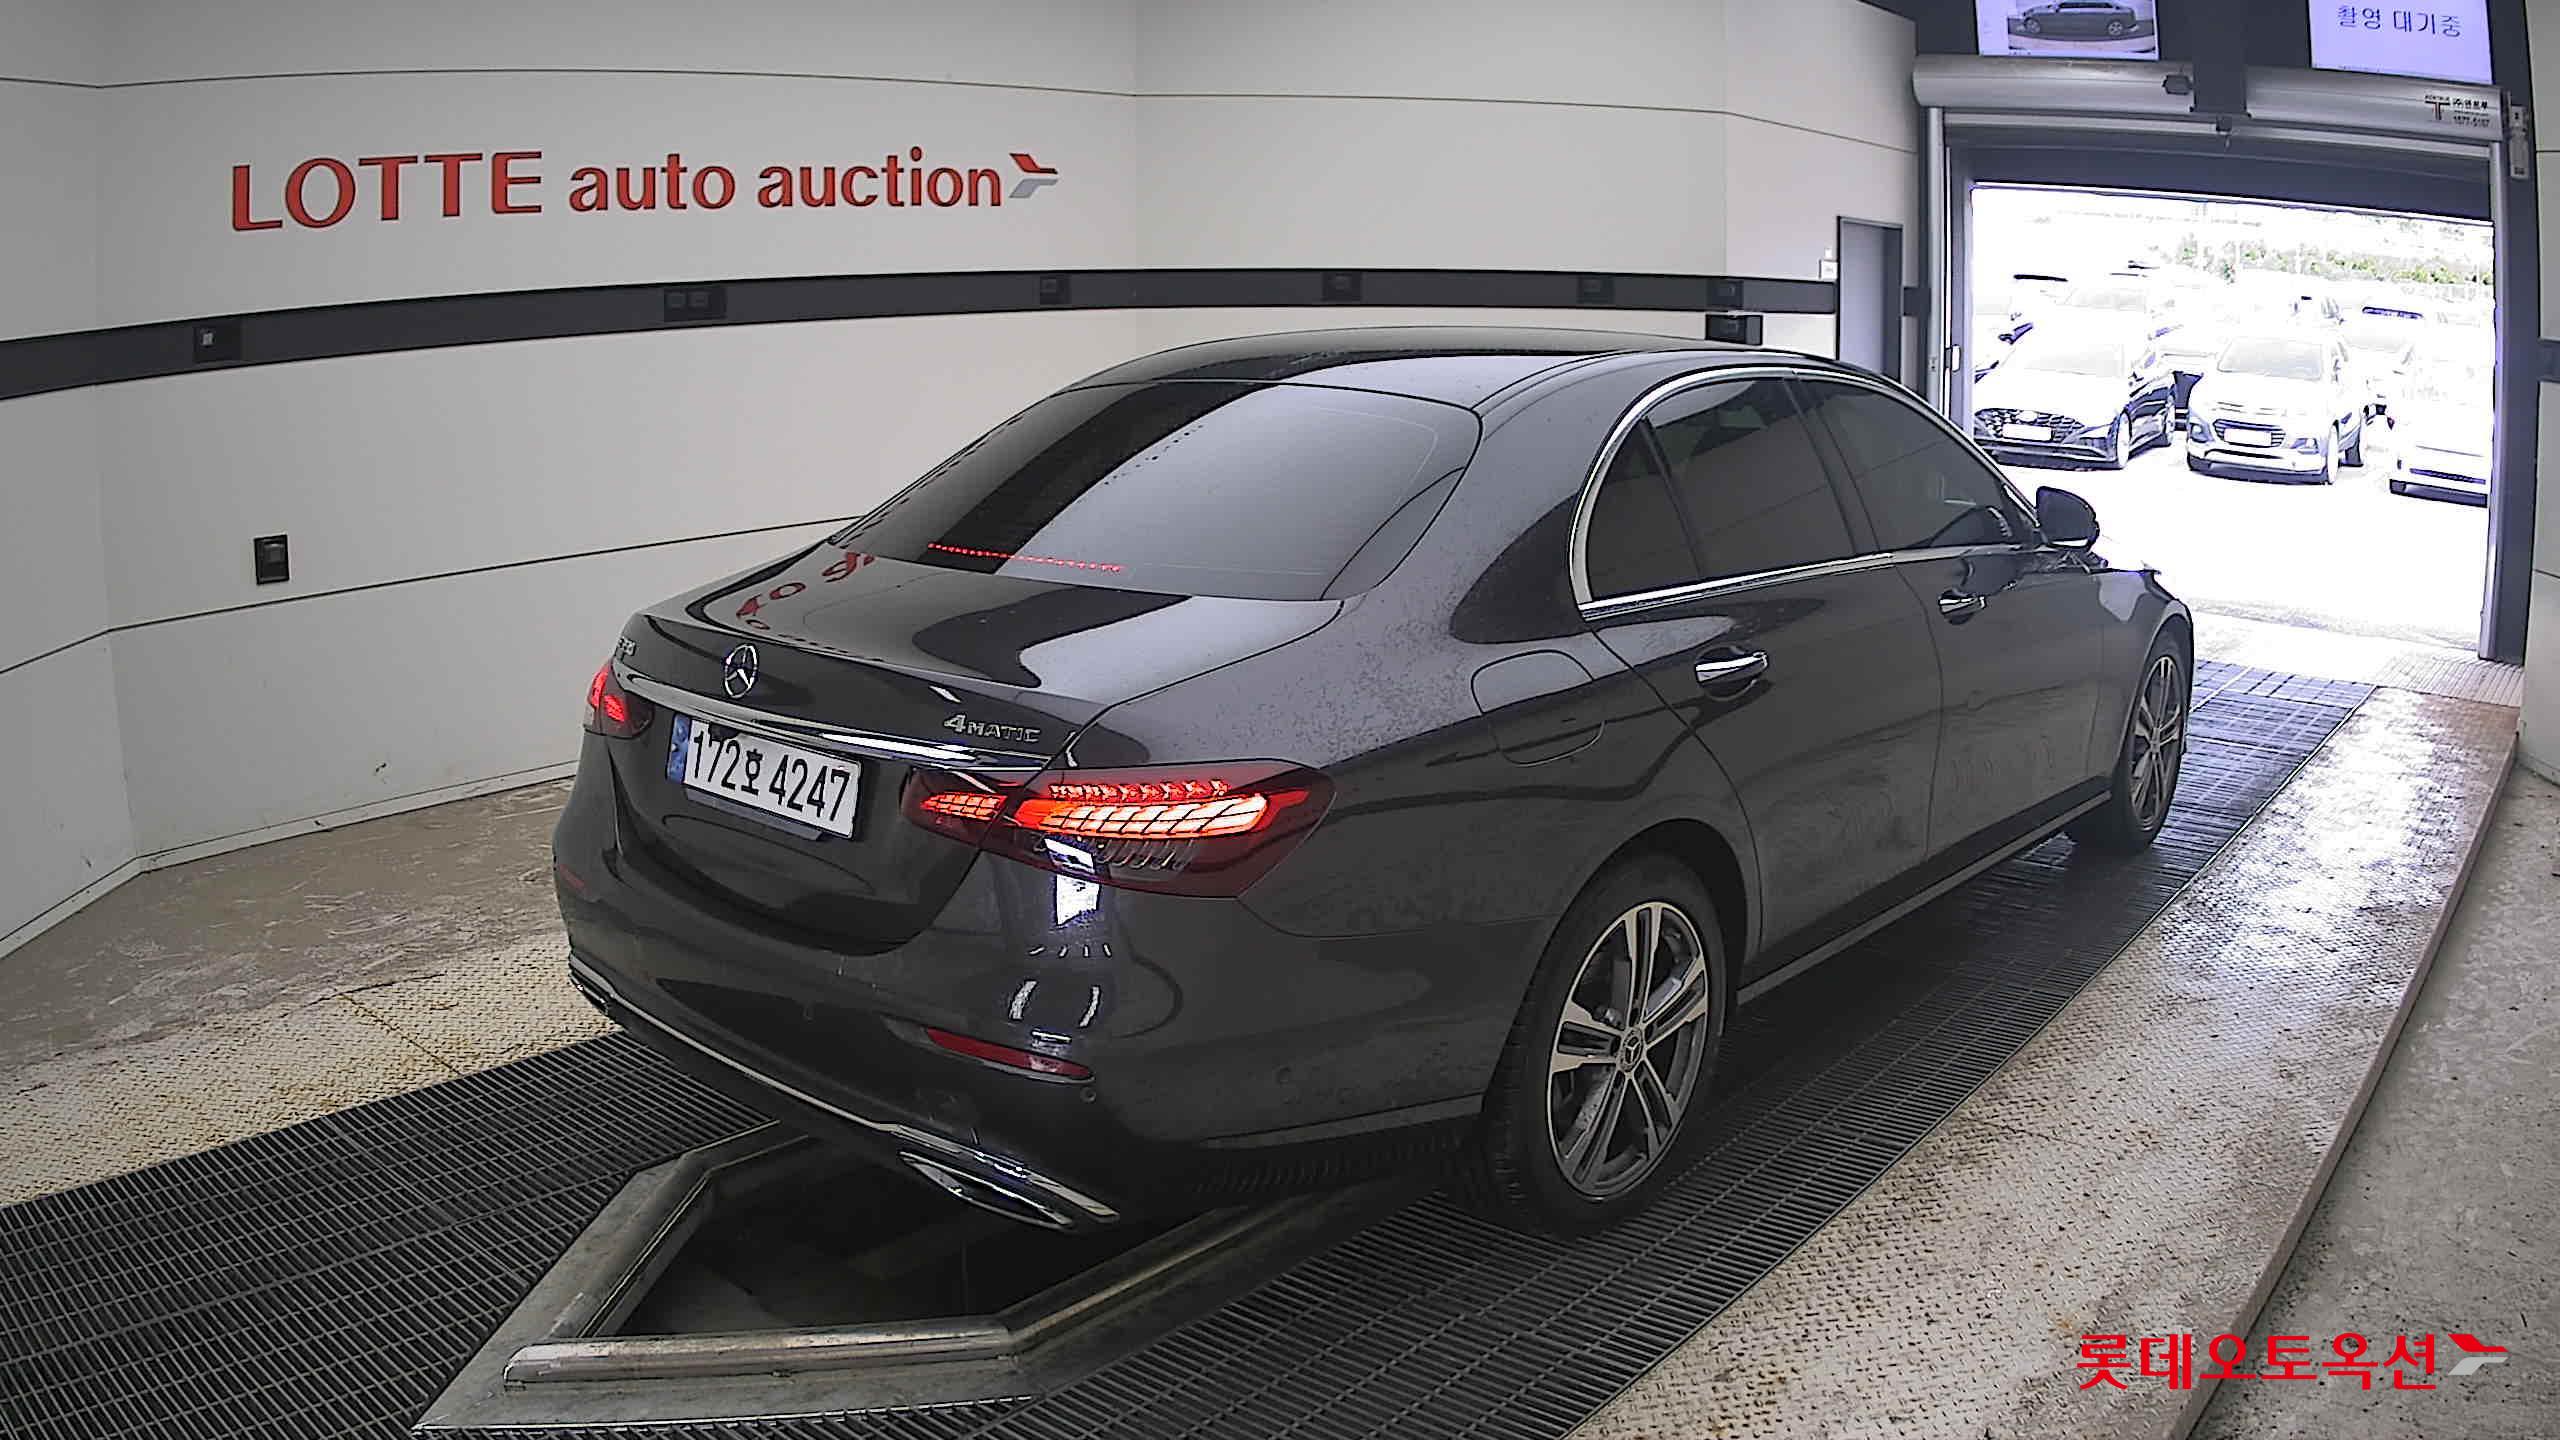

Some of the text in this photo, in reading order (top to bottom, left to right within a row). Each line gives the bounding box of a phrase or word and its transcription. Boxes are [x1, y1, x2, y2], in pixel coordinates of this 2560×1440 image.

[2337, 5, 2461, 38] 촬영 대기중
[231, 145, 1003, 232] LOTTE auto auction
[943, 713, 1042, 743] 4MATIC
[768, 753, 851, 822] 4247
